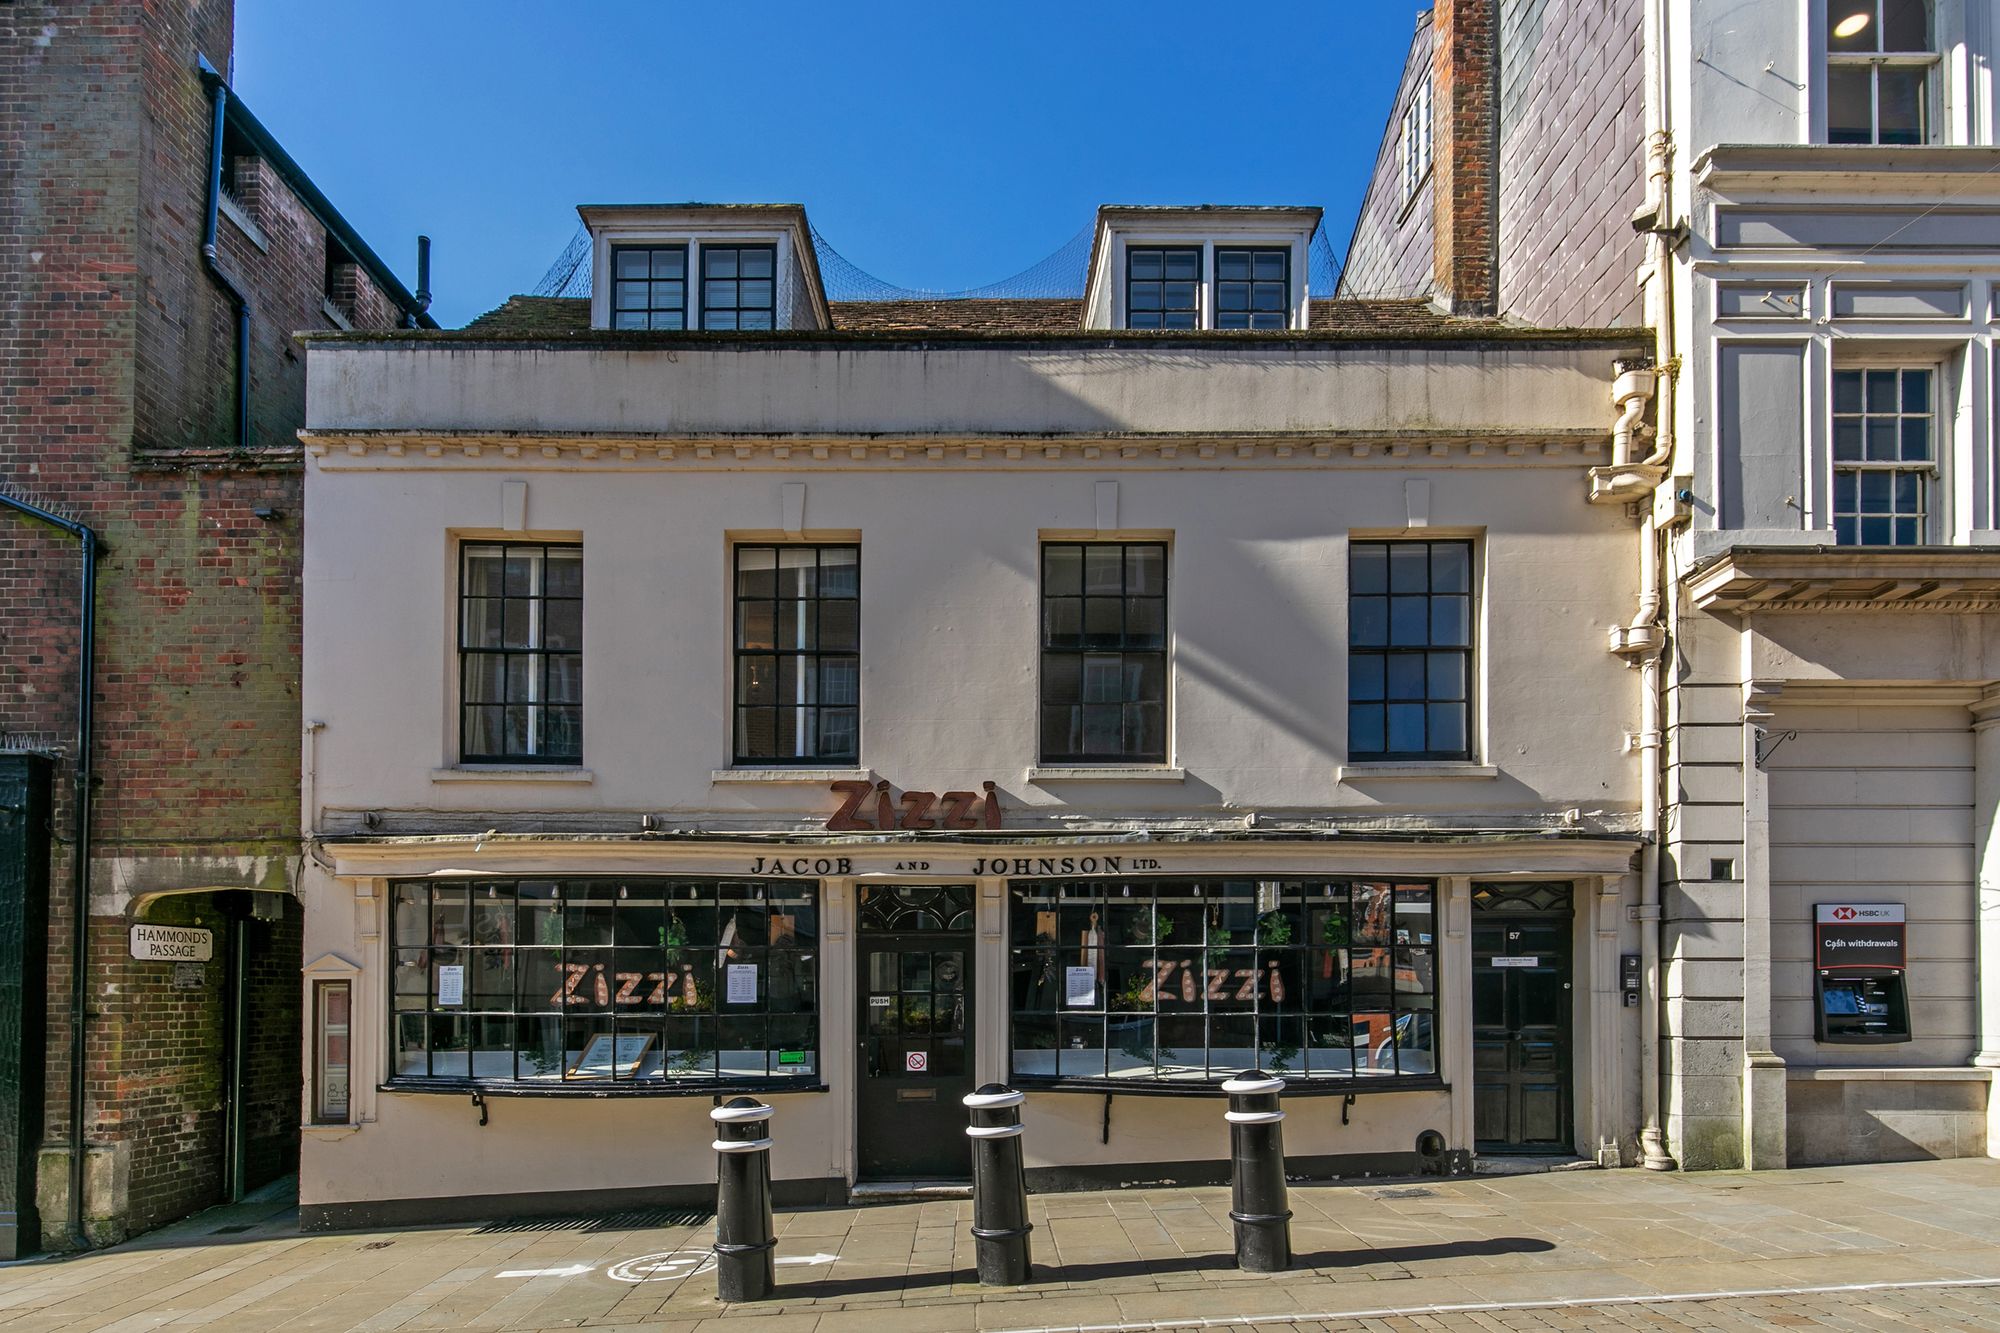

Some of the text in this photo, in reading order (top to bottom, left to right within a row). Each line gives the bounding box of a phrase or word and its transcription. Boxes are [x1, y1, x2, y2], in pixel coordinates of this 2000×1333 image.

[826, 780, 1001, 831] Zizzi
[751, 856, 1162, 875] JACOB AND JOHNSON LTD.
[137, 928, 208, 944] HAMMOND'S
[1509, 931, 1520, 939] 57
[1825, 939, 1898, 948] Cash withdrawals
[150, 943, 196, 957] PASSAGE
[550, 963, 698, 1007] Zizzi
[1138, 959, 1285, 1003] Zizzi
